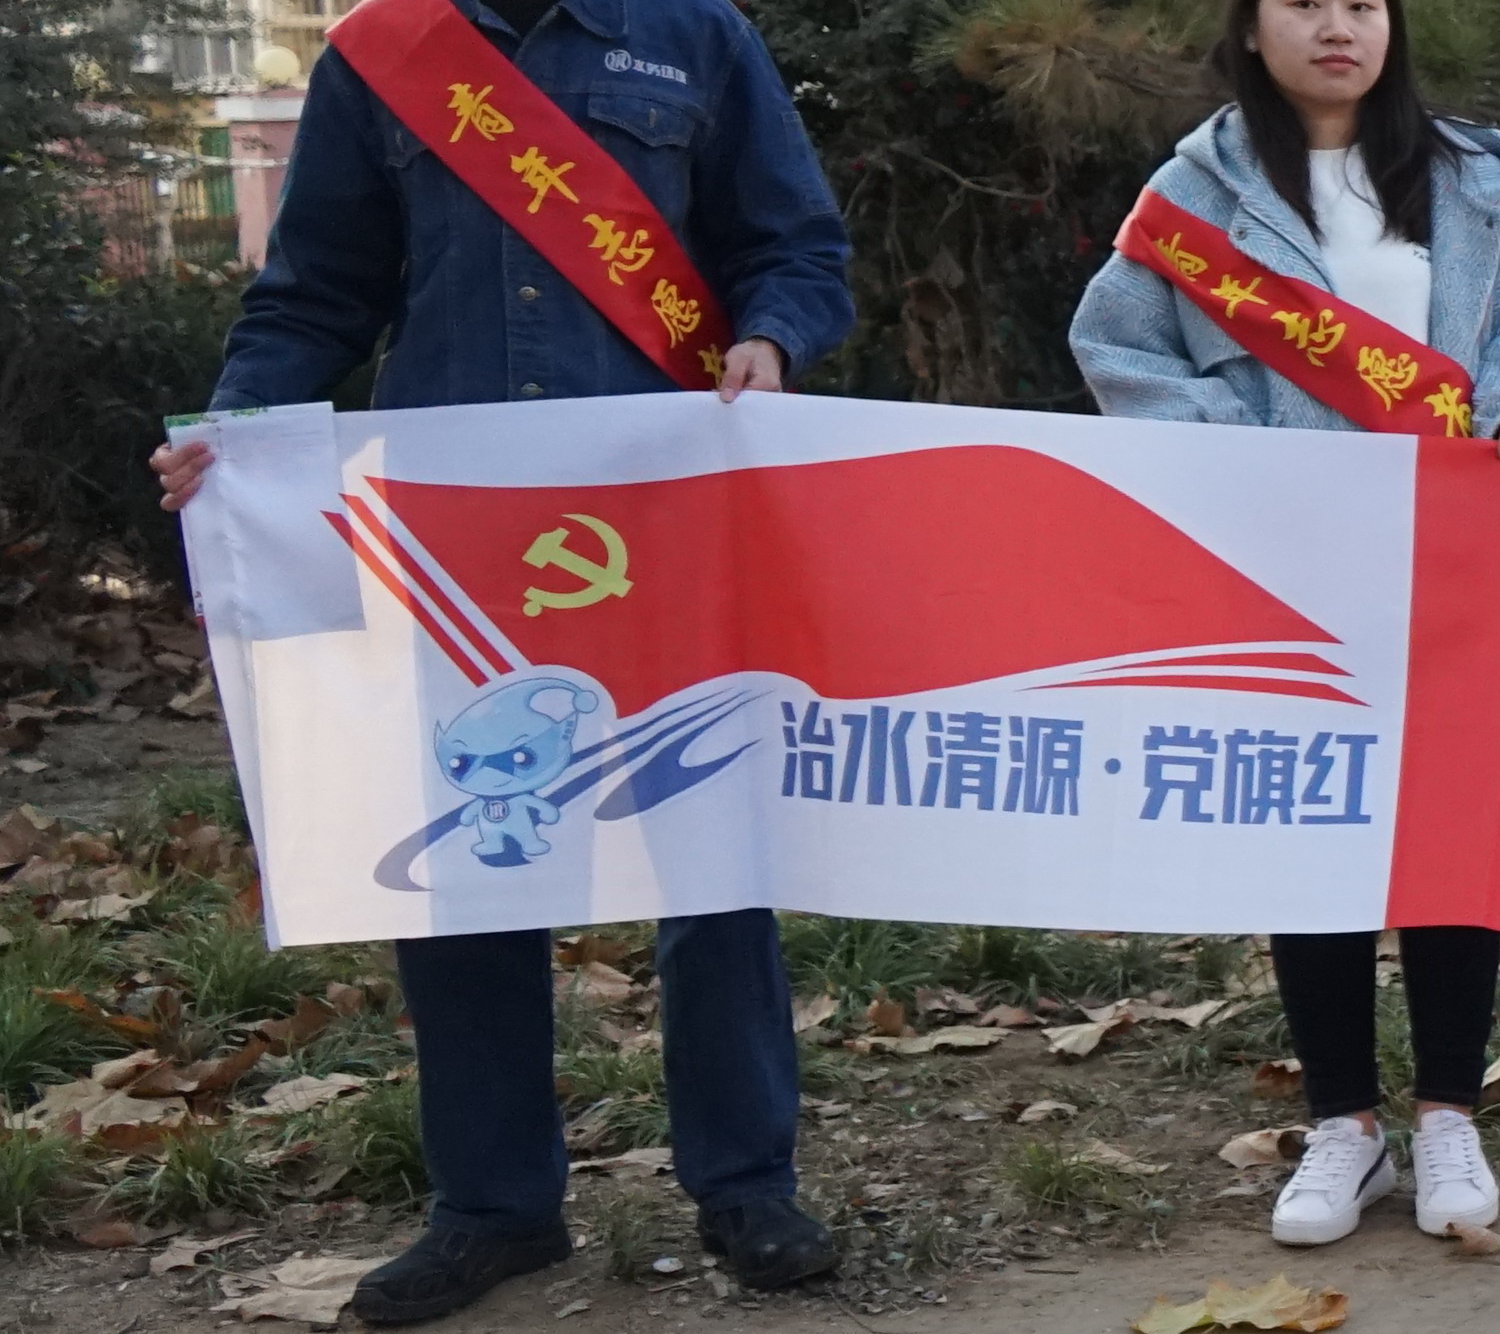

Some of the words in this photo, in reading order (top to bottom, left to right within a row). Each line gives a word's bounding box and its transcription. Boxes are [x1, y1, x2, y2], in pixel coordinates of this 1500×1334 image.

[778, 699, 1380, 827] 治水清源·党旗红
